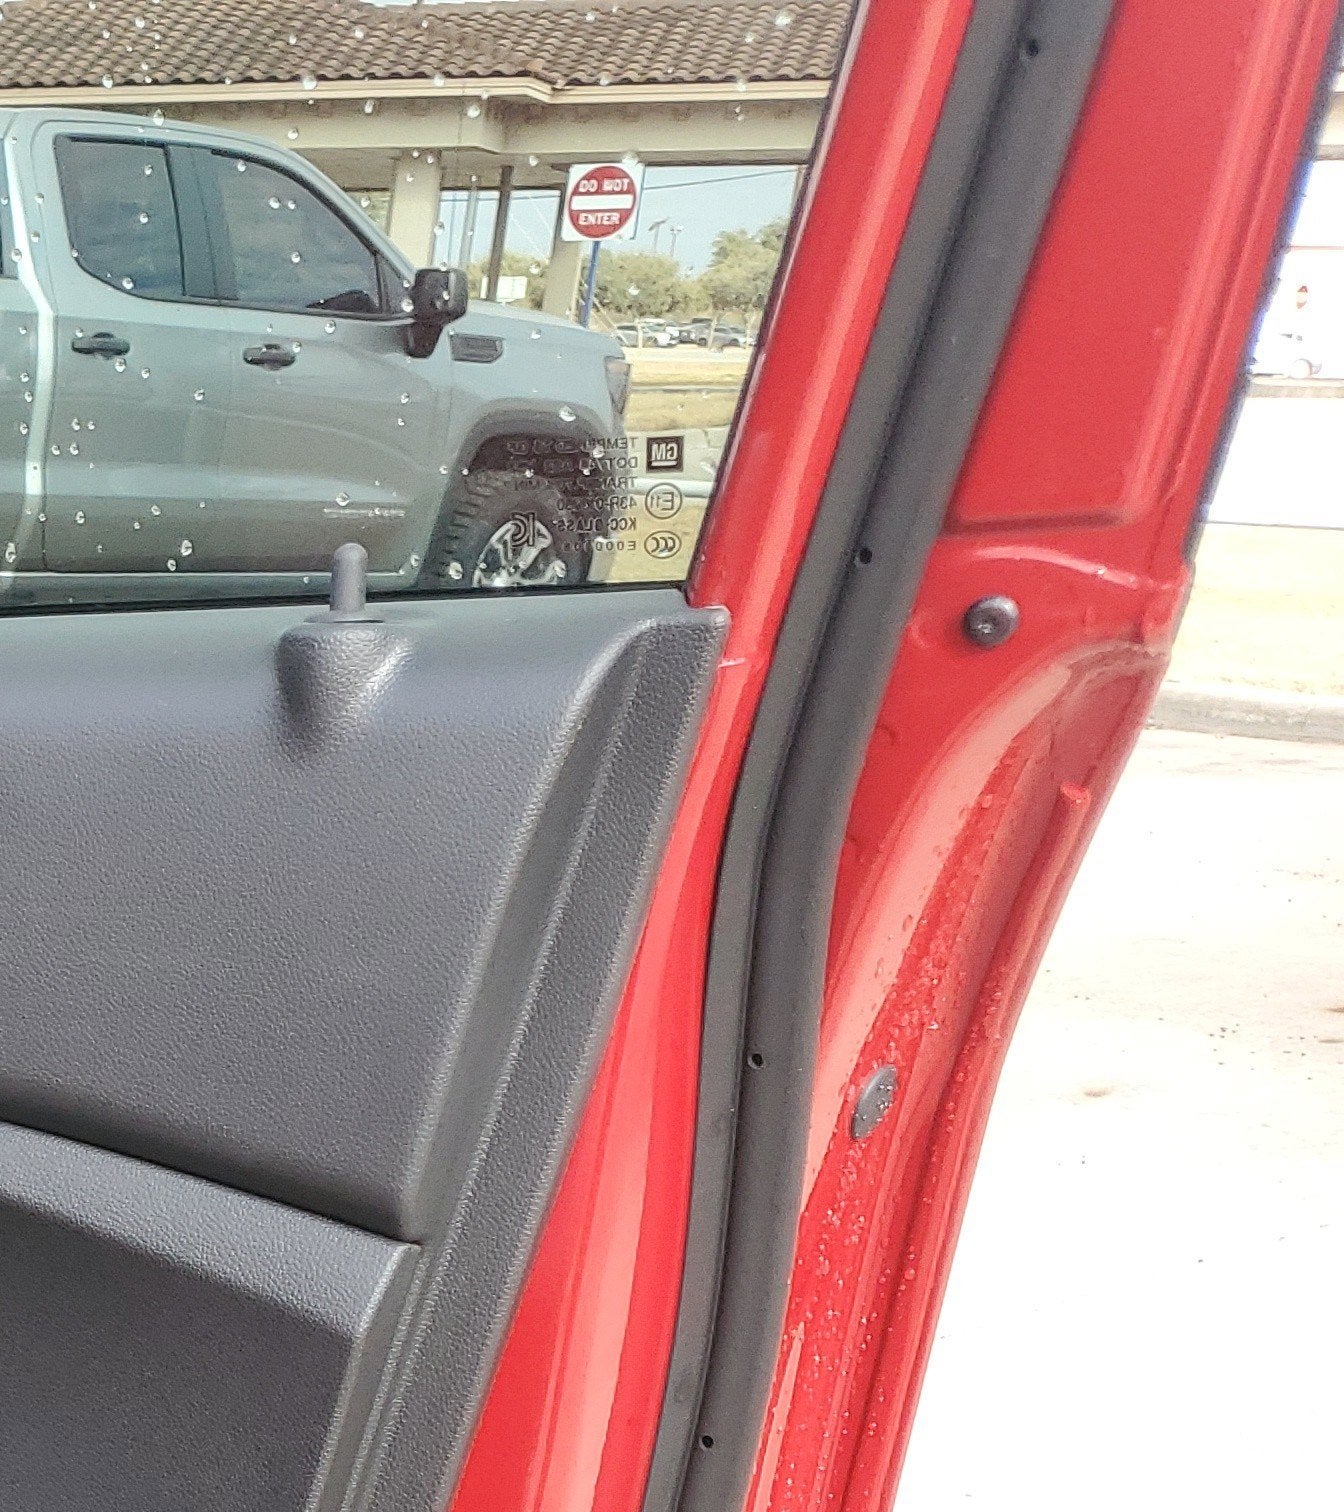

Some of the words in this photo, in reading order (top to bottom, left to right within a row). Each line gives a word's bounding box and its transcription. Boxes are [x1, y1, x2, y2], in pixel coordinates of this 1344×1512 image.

[578, 180, 598, 193] DO
[602, 178, 630, 192] NOT
[578, 212, 620, 226] ENTER
